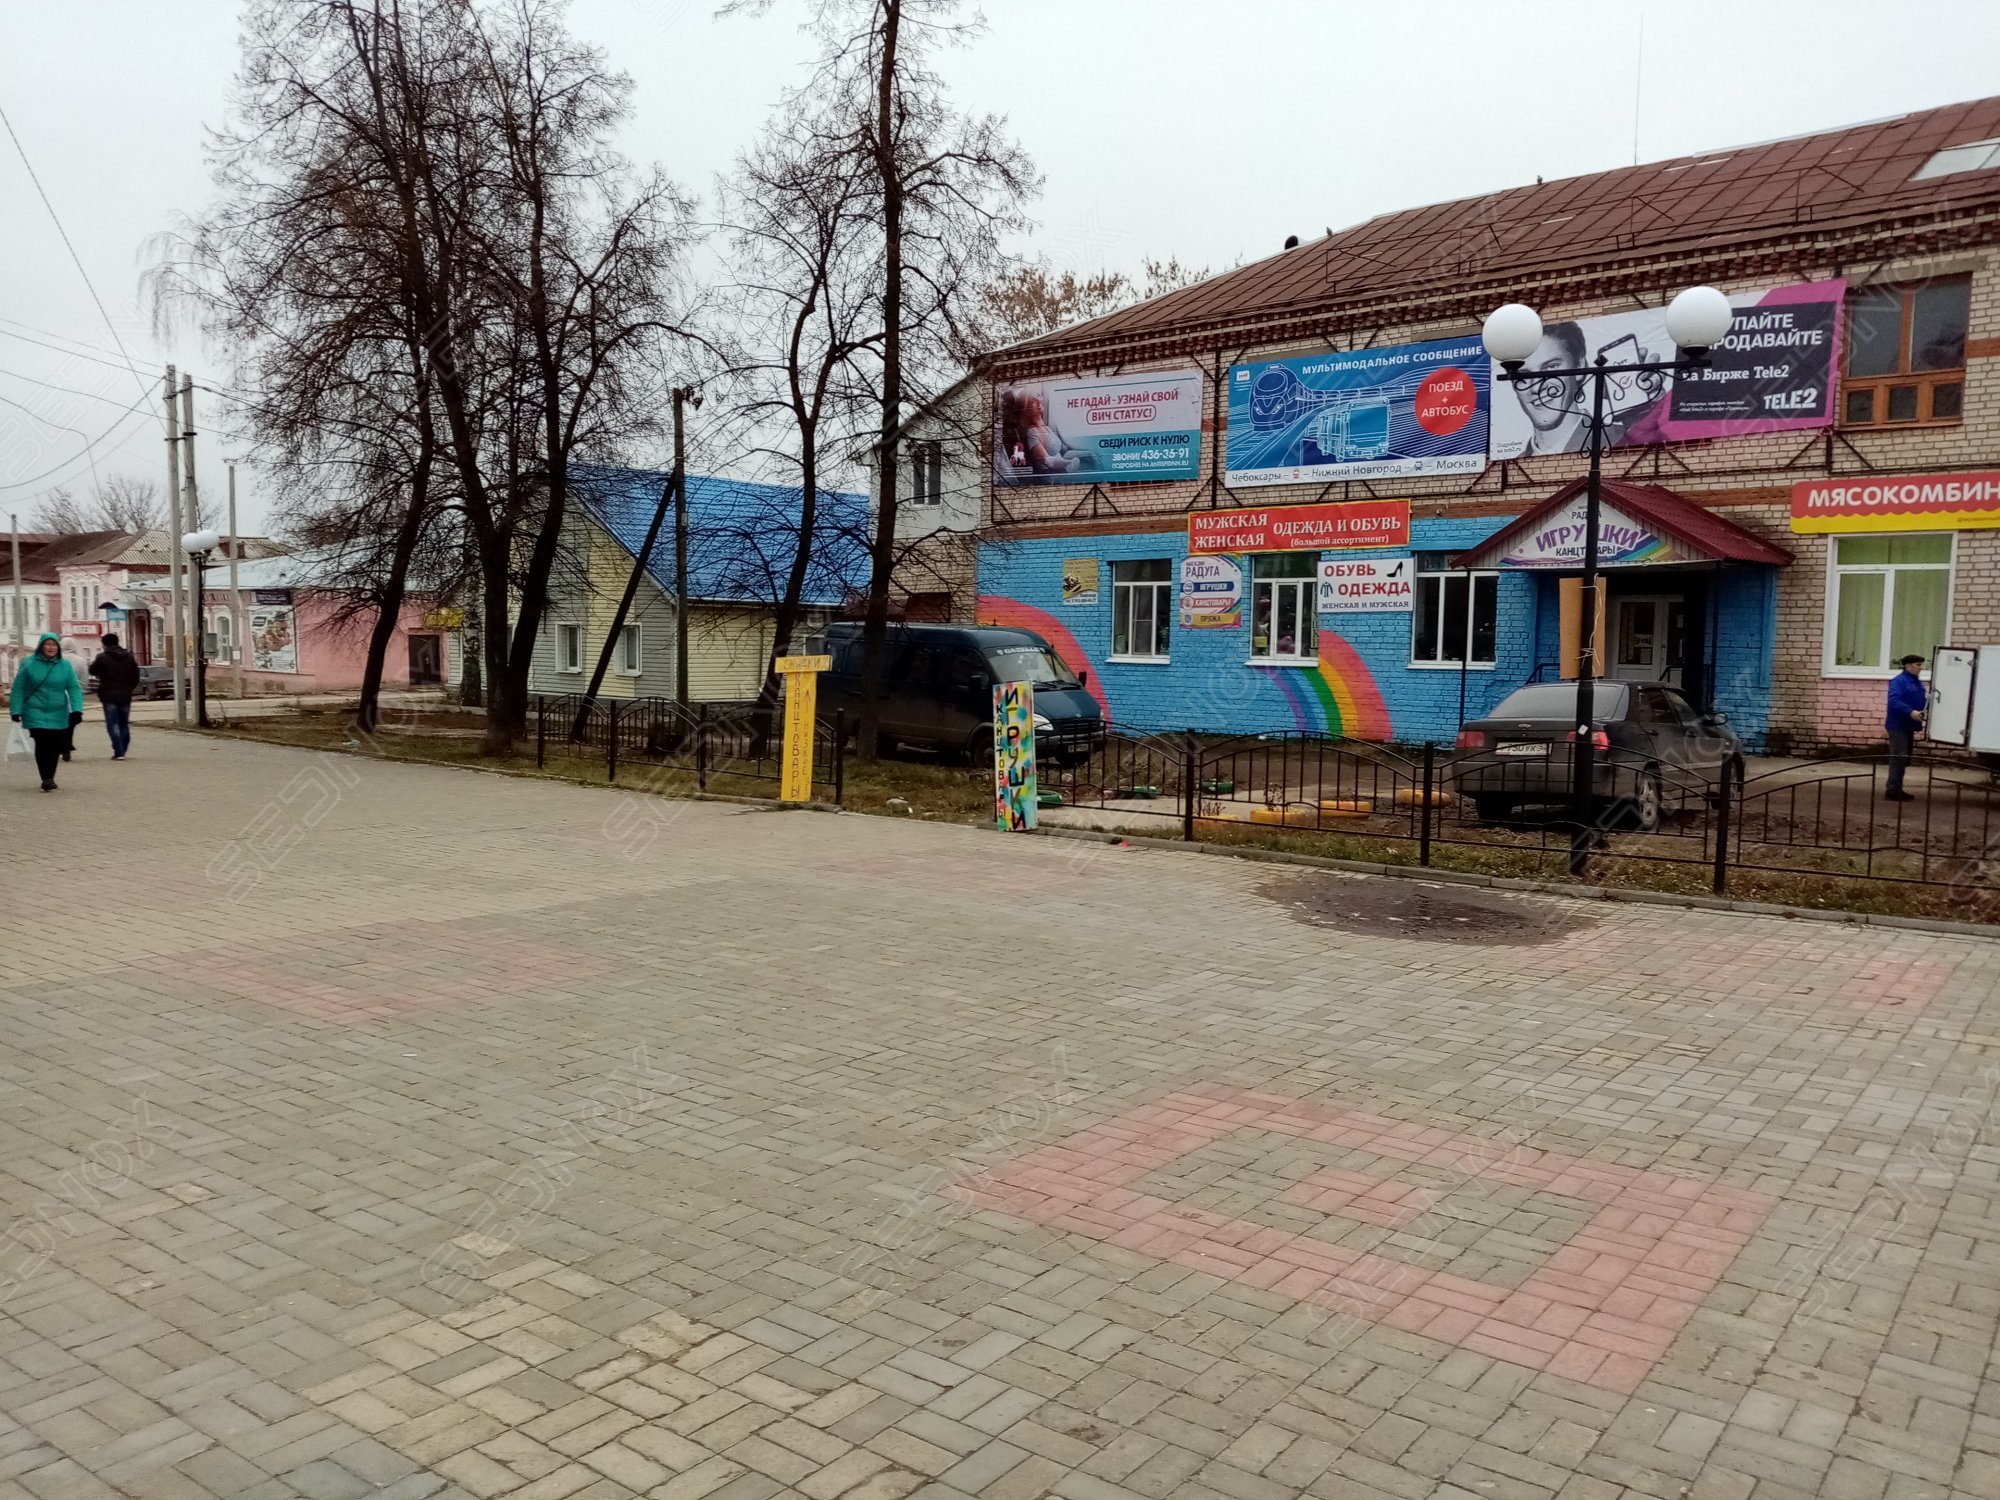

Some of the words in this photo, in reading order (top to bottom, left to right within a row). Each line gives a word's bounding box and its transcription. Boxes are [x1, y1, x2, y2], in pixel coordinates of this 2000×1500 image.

[1709, 329, 1823, 352] РОДАВАЙТЕ
[1302, 354, 1410, 376] МУЛЬТИМОДАЛЬНОЕ
[1412, 345, 1483, 363] СООБЩЕНИЕ
[1702, 368, 1749, 383] Бирже
[1753, 365, 1790, 379] Tele2
[1428, 380, 1464, 393] ПОЕЗД
[1067, 398, 1079, 408] НЕ
[1080, 394, 1111, 408] ГАДАЙ
[1117, 391, 1150, 405] УЗНАЙ
[1151, 389, 1179, 402] СВОЙ
[1764, 387, 1819, 410] TELE2
[1092, 411, 1111, 422] ВИЧ
[1113, 408, 1152, 420] СТАТУС!
[1421, 405, 1469, 418] АВТОБУС
[1099, 437, 1127, 449] СВЕДИ
[1127, 436, 1151, 447] РИСК
[1152, 436, 1160, 445] К
[1161, 434, 1190, 445] НУЛЮ
[1141, 447, 1190, 460] 436-35-91
[1231, 471, 1281, 483] Чебоксары
[1311, 467, 1350, 479] Нижний
[1352, 464, 1402, 477] Новгород
[1436, 459, 1477, 470] Москва
[1808, 481, 2000, 508] МЯСОКОМБИН
[1195, 513, 1268, 530] МУЖСКАЯ
[1273, 519, 1334, 536] ОДЕЖДА
[1336, 518, 1347, 532] И
[1350, 516, 1401, 531] ОБУВЬ
[1194, 533, 1265, 549] ЖЕНСКАЯ
[1290, 536, 1331, 549] (большой
[1331, 533, 1389, 546] ассортимент)
[1556, 546, 1616, 557] КАНЦТАРЫ
[1185, 566, 1220, 579] РАДУГА
[1324, 564, 1377, 577] ОБУВЬ
[1337, 581, 1411, 597] ОДЕЖДА
[791, 673, 801, 799] КАНЦТОВАРЫ
[1005, 687, 1027, 831] ИГРУШКИ
